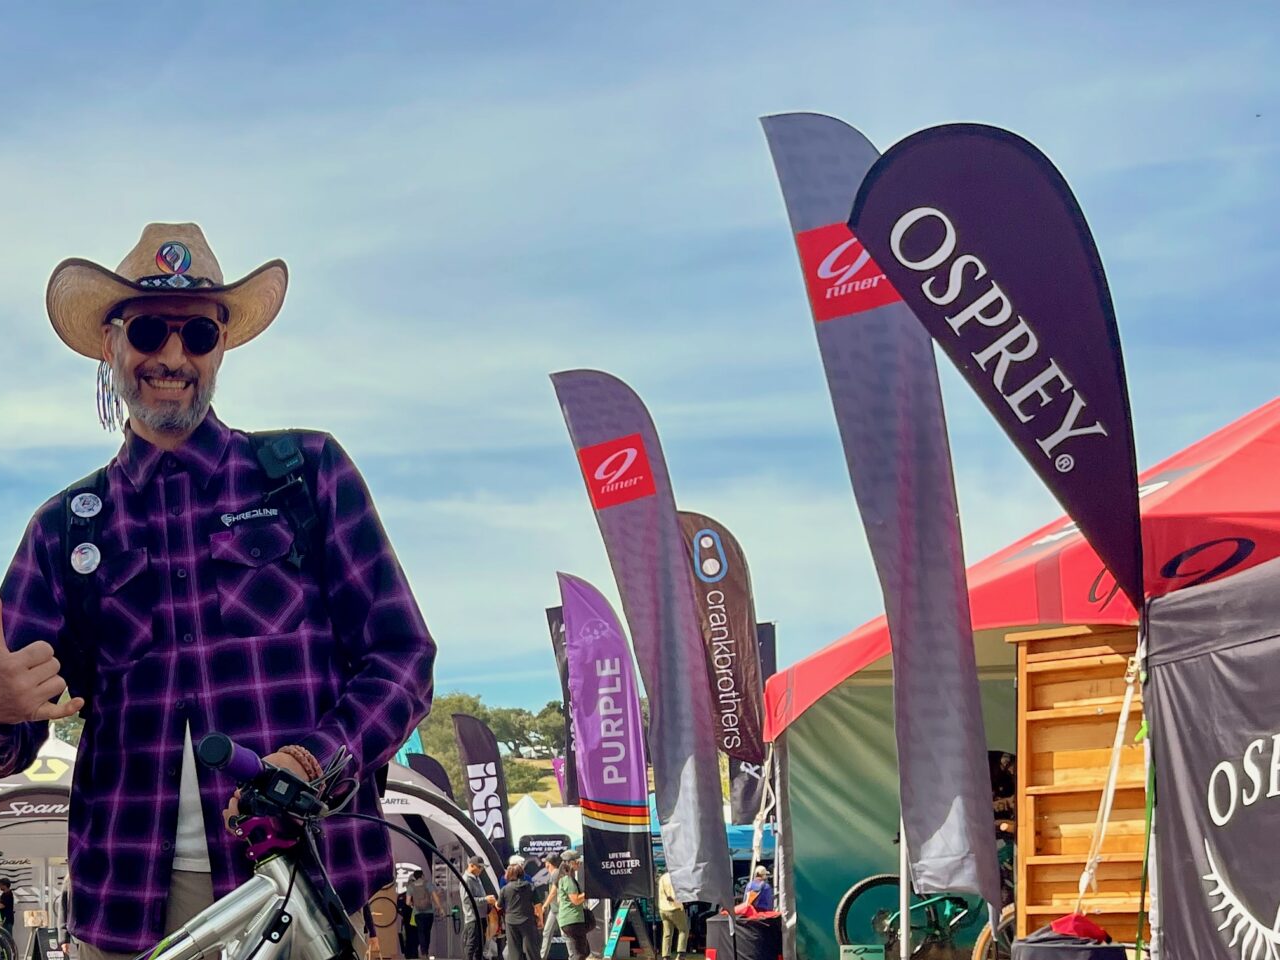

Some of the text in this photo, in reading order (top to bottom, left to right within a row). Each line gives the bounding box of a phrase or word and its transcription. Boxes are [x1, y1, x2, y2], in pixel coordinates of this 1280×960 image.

[825, 273, 887, 299] niner
[890, 206, 1108, 460] OSPREY
[601, 475, 643, 494] niner
[706, 590, 742, 750] crankbrothers
[595, 657, 628, 786] PURPLE
[601, 859, 640, 869] SEA OTTER
